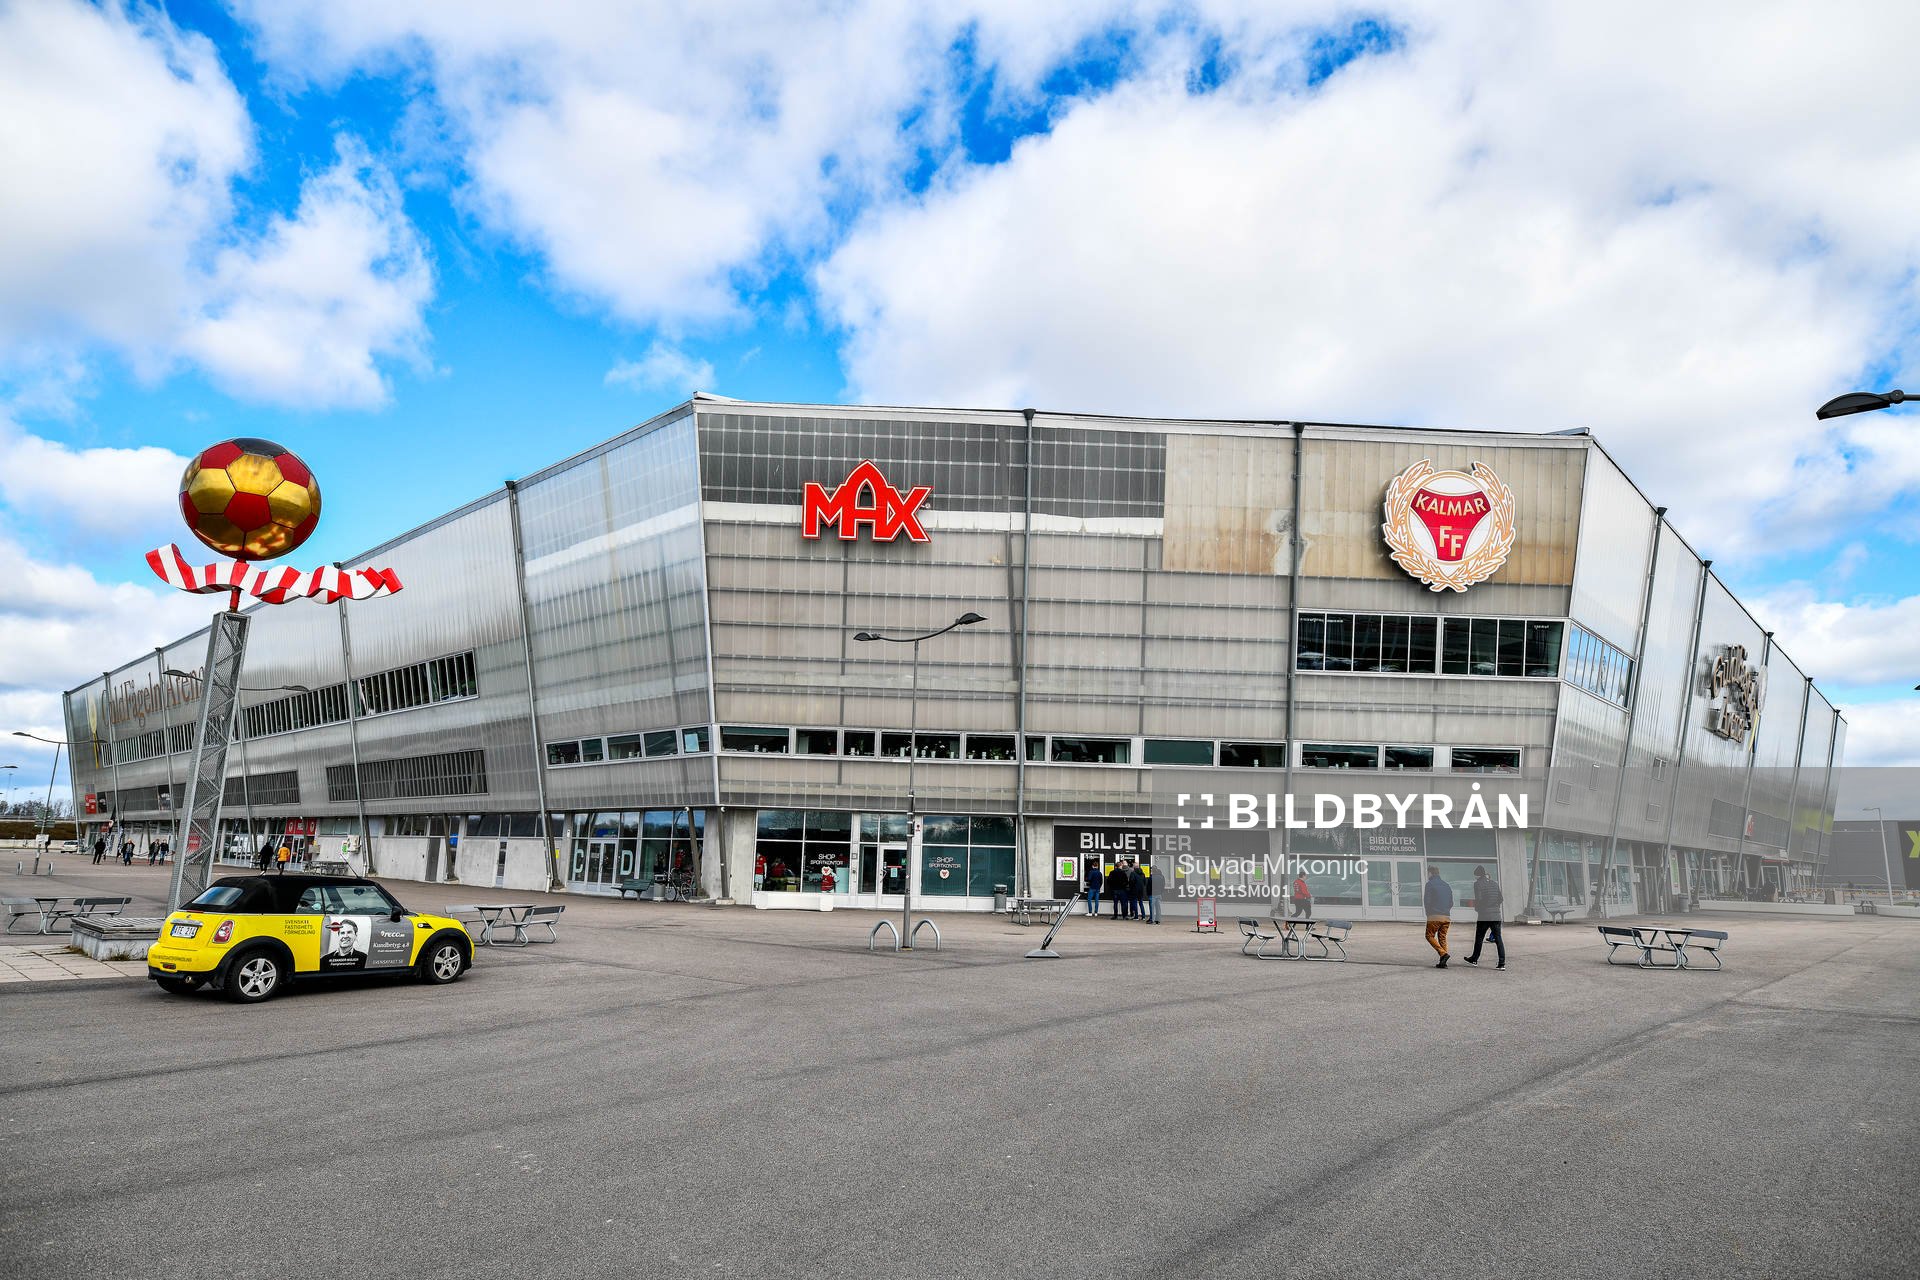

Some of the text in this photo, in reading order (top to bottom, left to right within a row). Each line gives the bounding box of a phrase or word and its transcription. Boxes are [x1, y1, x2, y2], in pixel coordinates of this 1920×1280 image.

[802, 459, 934, 543] MAX
[1415, 493, 1487, 517] KALMAR
[1439, 525, 1464, 557] FF
[1080, 832, 1192, 851] BILJETTER
[1369, 836, 1416, 845] BIBLIOTEK
[620, 849, 633, 875] D
